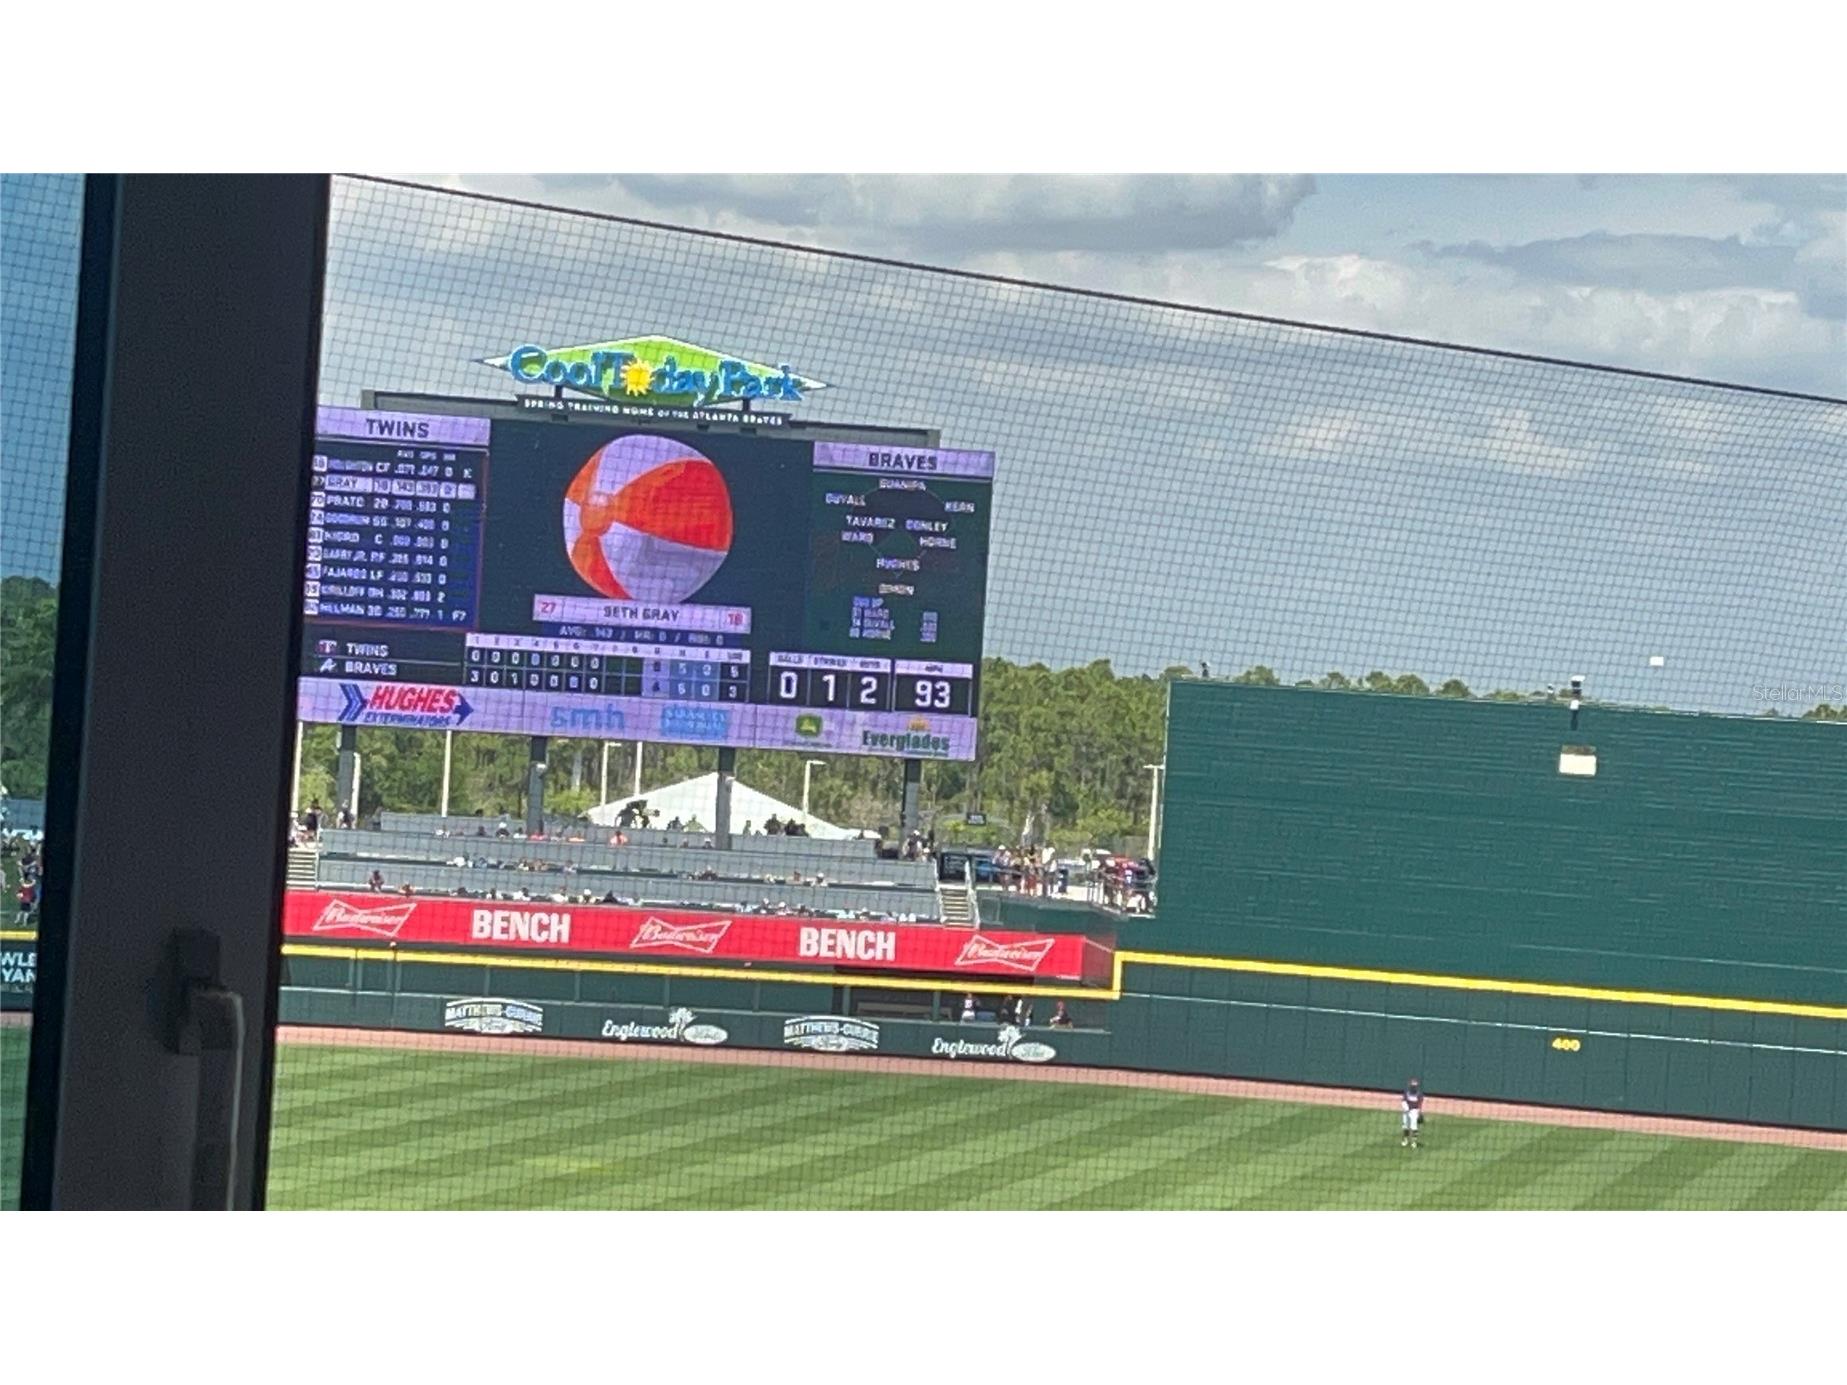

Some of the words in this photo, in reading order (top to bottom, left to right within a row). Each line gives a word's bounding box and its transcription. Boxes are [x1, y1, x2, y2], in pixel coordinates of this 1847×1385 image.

[718, 358, 804, 401] Park
[524, 399, 564, 411] SPRING
[568, 402, 619, 415] TRAINING
[623, 405, 654, 417] HOME
[692, 410, 740, 424] ATLANTA
[366, 418, 430, 438] TWINS
[869, 453, 938, 470] BRAVES
[540, 602, 557, 614] 27
[603, 605, 639, 619] SETH
[642, 607, 680, 622] GRAY
[346, 642, 389, 657] TWINS
[345, 661, 397, 676] BRAVES
[369, 685, 460, 714] HUGHES
[780, 671, 797, 699] 0
[822, 674, 836, 701] 1
[860, 676, 878, 705] 2
[915, 680, 951, 708] 93
[550, 703, 625, 731] smh
[862, 730, 950, 751] Everglades
[323, 904, 406, 926] Budweiser
[472, 909, 571, 943] BENCH
[640, 923, 720, 946] Budweiser
[799, 927, 896, 961] BENCH
[601, 1018, 679, 1042] Englewood
[931, 1037, 1007, 1059] Englewood
[1552, 1037, 1582, 1052] 400
